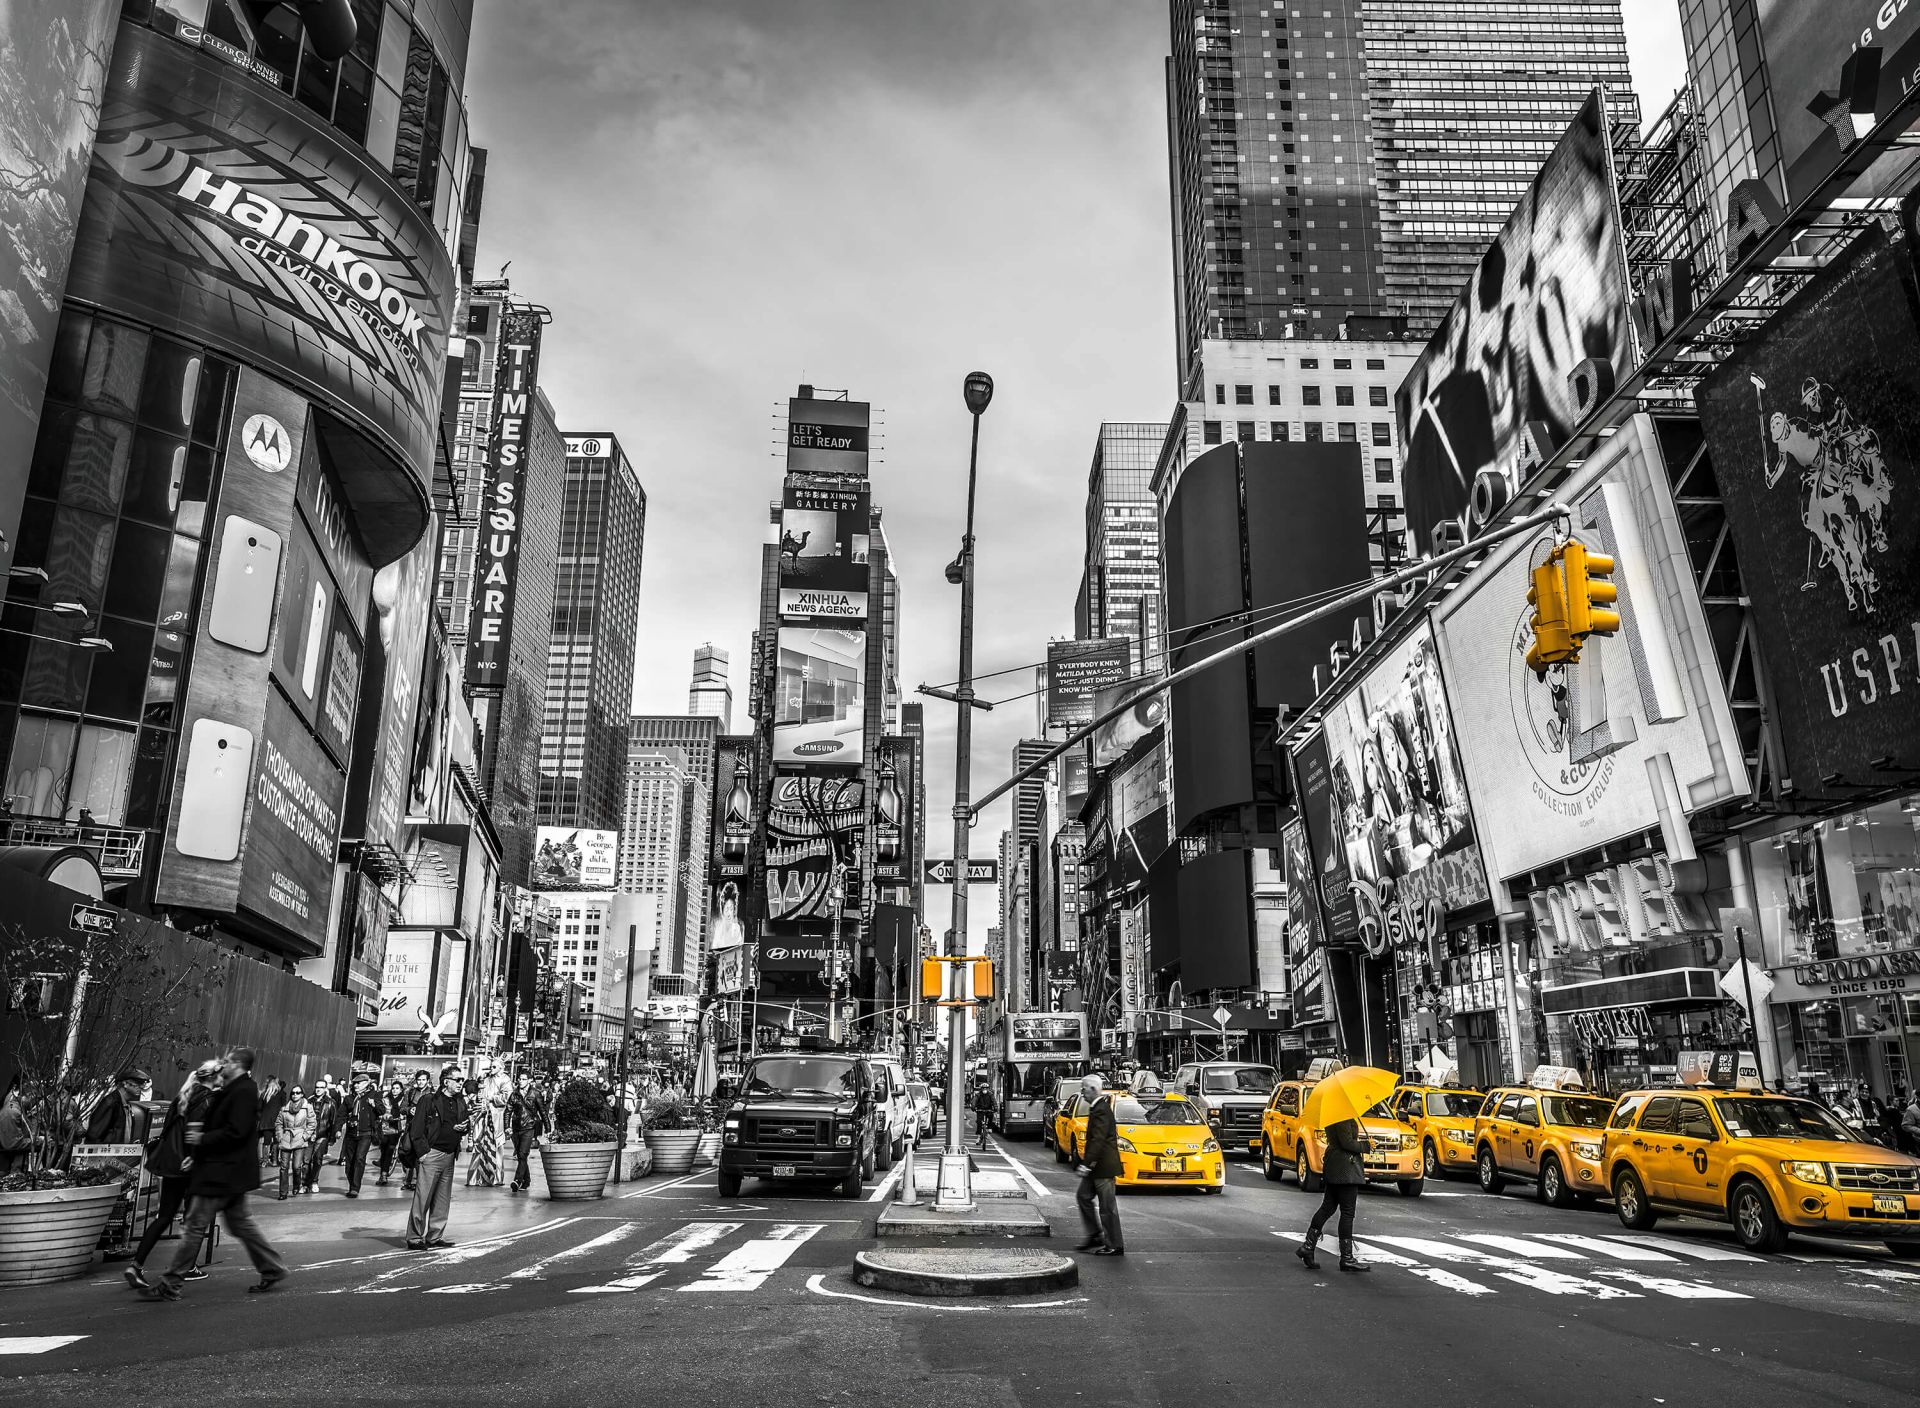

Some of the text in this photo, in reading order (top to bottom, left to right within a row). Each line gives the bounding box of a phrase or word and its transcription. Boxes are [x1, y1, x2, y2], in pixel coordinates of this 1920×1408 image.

[239, 235, 345, 303] driving
[345, 296, 424, 373] emotion
[793, 424, 822, 436] LET'S
[793, 435, 852, 450] GET READY
[481, 344, 531, 642] TIMES SQUARE
[830, 492, 858, 502] XINHUA
[796, 499, 857, 511] GALLERY
[799, 593, 850, 607] XINHUA
[787, 603, 862, 616] NEWS AGENCY
[1312, 590, 1395, 698] 1540
[477, 661, 498, 670] NYC
[1099, 659, 1121, 667] KNEW
[1820, 622, 1920, 718] USP
[1079, 677, 1094, 685] JUST
[1059, 686, 1081, 694] KNOW
[800, 743, 838, 753] SAMSUNG
[265, 739, 336, 835] THOUSANDS OF WAYS TO
[1533, 745, 1617, 816] COLLECTION EXCLUSIV
[258, 773, 298, 831] CUSTOMIZE
[297, 810, 313, 847] YOUR
[682, 791, 693, 852] NOVOTEL
[1528, 852, 1692, 958] FOREVER
[83, 913, 97, 925] ONE
[396, 954, 407, 963] US
[1125, 917, 1138, 1005] PALACE
[388, 964, 420, 973] ON THE
[1825, 957, 1872, 983] POLO
[1830, 978, 1906, 995] SINCE 1890
[1570, 1009, 1636, 1041] FOREVER
[915, 1046, 925, 1066] tkts
